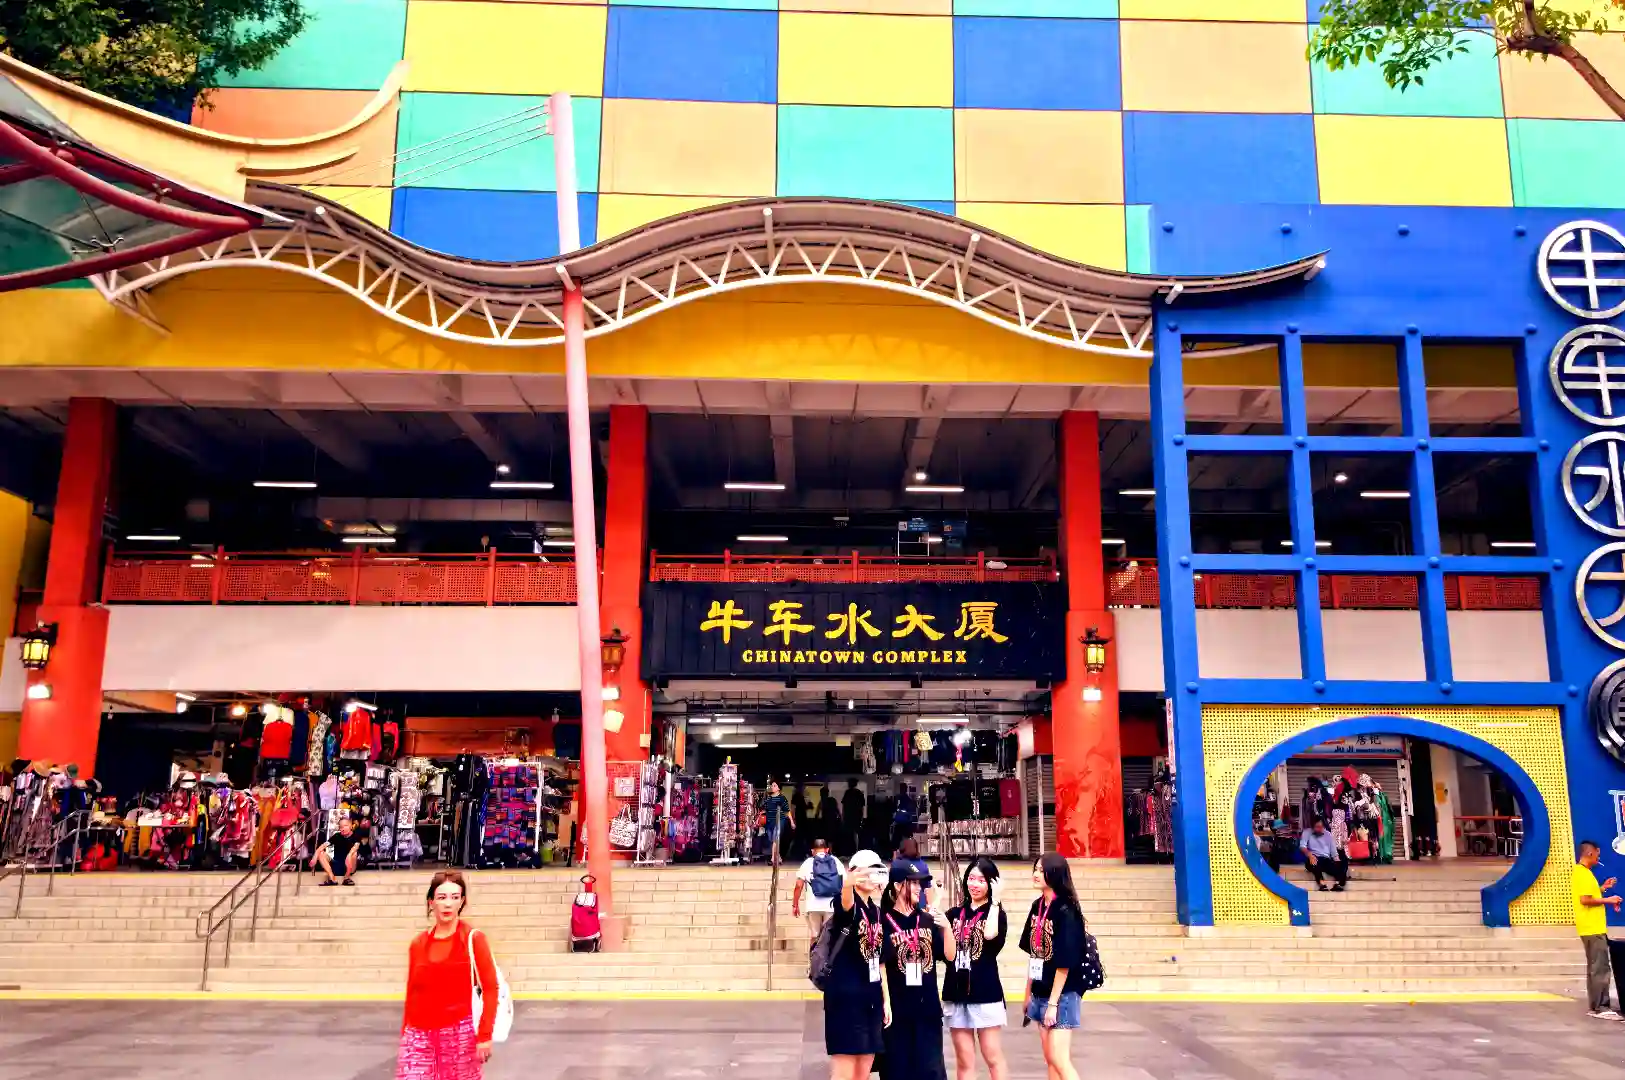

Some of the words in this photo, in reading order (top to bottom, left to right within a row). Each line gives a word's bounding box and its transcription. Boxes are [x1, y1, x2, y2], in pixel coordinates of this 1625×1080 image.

[699, 600, 1009, 645] 牛车水大厦
[742, 649, 865, 664] CHINATOWN
[872, 649, 968, 664] COMPLEX
